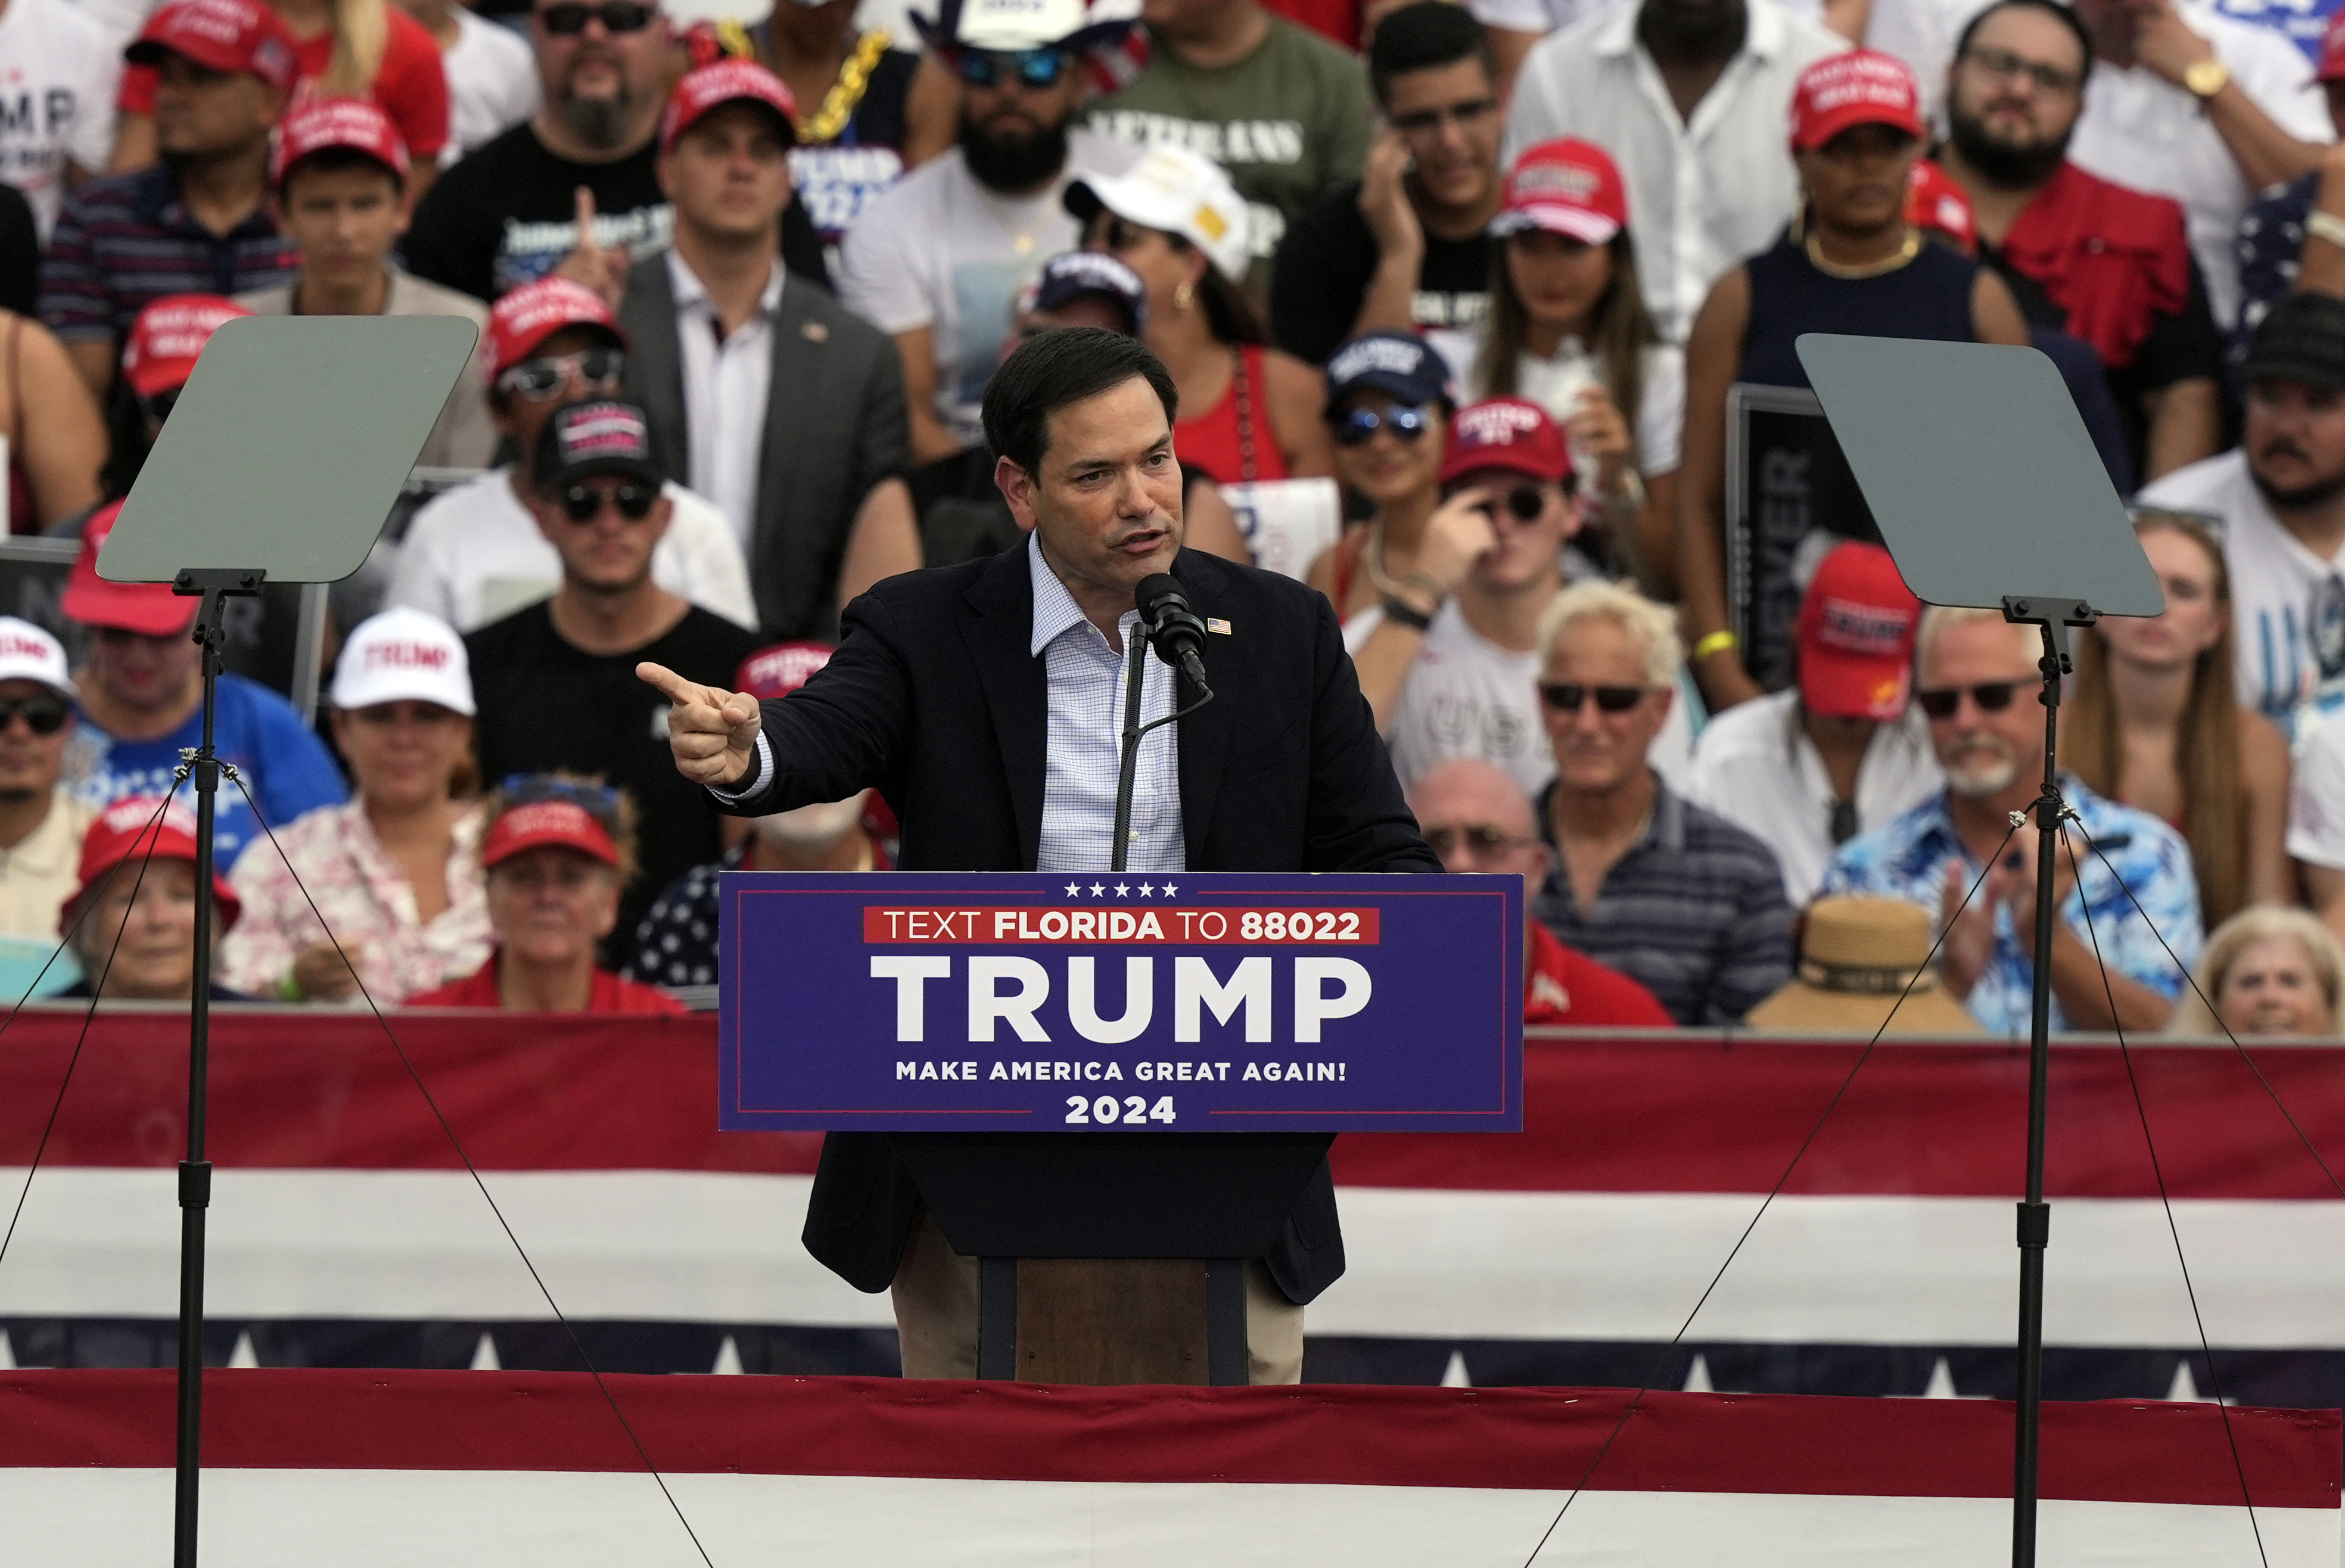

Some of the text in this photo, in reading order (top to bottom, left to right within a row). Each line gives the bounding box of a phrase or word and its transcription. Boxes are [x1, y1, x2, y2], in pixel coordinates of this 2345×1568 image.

[884, 911, 1360, 940] TEXT FLORIDA TO 88022
[870, 956, 1372, 1044] TRUMP
[896, 1062, 1345, 1081] MAKE AMERICA GREAT AGAIN!
[1065, 1096, 1176, 1124] 2024
